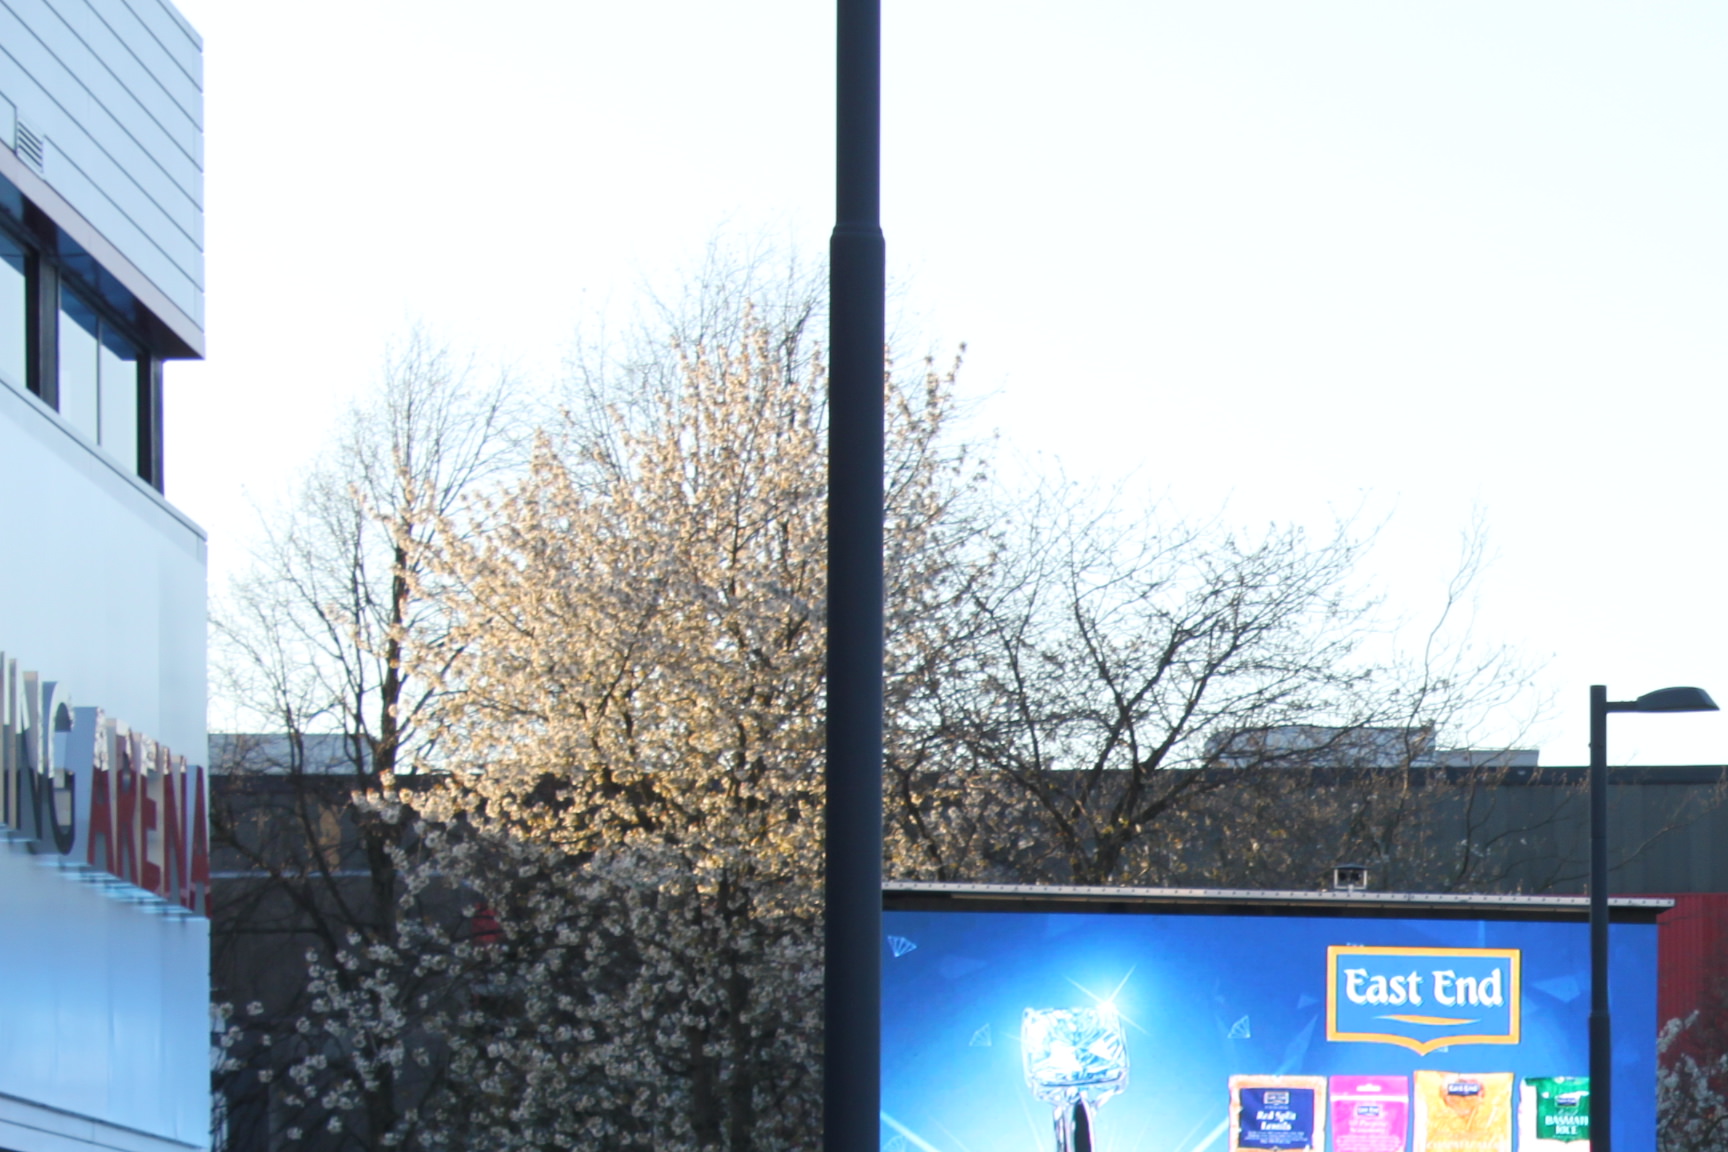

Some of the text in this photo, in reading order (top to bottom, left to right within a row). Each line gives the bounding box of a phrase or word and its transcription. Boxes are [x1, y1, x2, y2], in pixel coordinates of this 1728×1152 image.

[86, 705, 212, 919] ARENA
[1344, 967, 1504, 1007] East End
